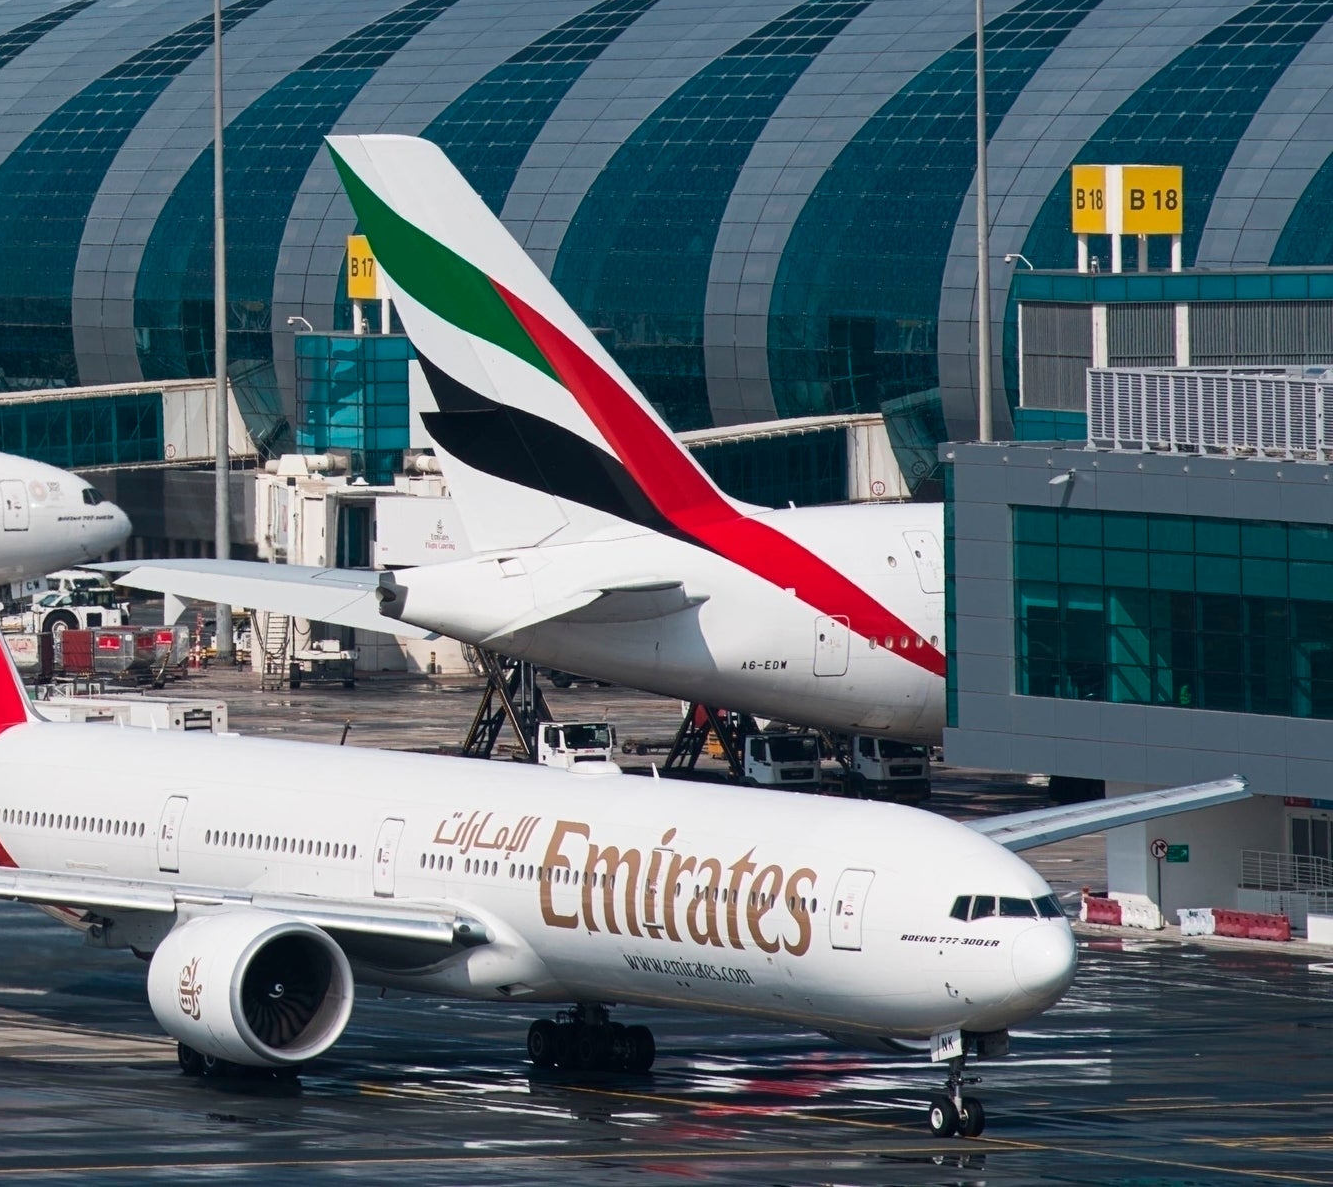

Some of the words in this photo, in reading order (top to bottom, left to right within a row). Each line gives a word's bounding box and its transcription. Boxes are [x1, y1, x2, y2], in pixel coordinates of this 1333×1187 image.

[1077, 189, 1085, 209] B
[1089, 189, 1103, 210] 18
[1130, 189, 1145, 210] B
[1153, 189, 1178, 210] 18
[351, 257, 359, 277] B
[362, 257, 373, 277] 17
[27, 581, 40, 591] CW
[741, 661, 787, 670] A6-EDW
[433, 811, 541, 859] الإمارات
[539, 820, 817, 957] Emirates
[901, 935, 937, 943] BOEING
[623, 953, 755, 986] www.emirates.com
[941, 1035, 955, 1052] NK
